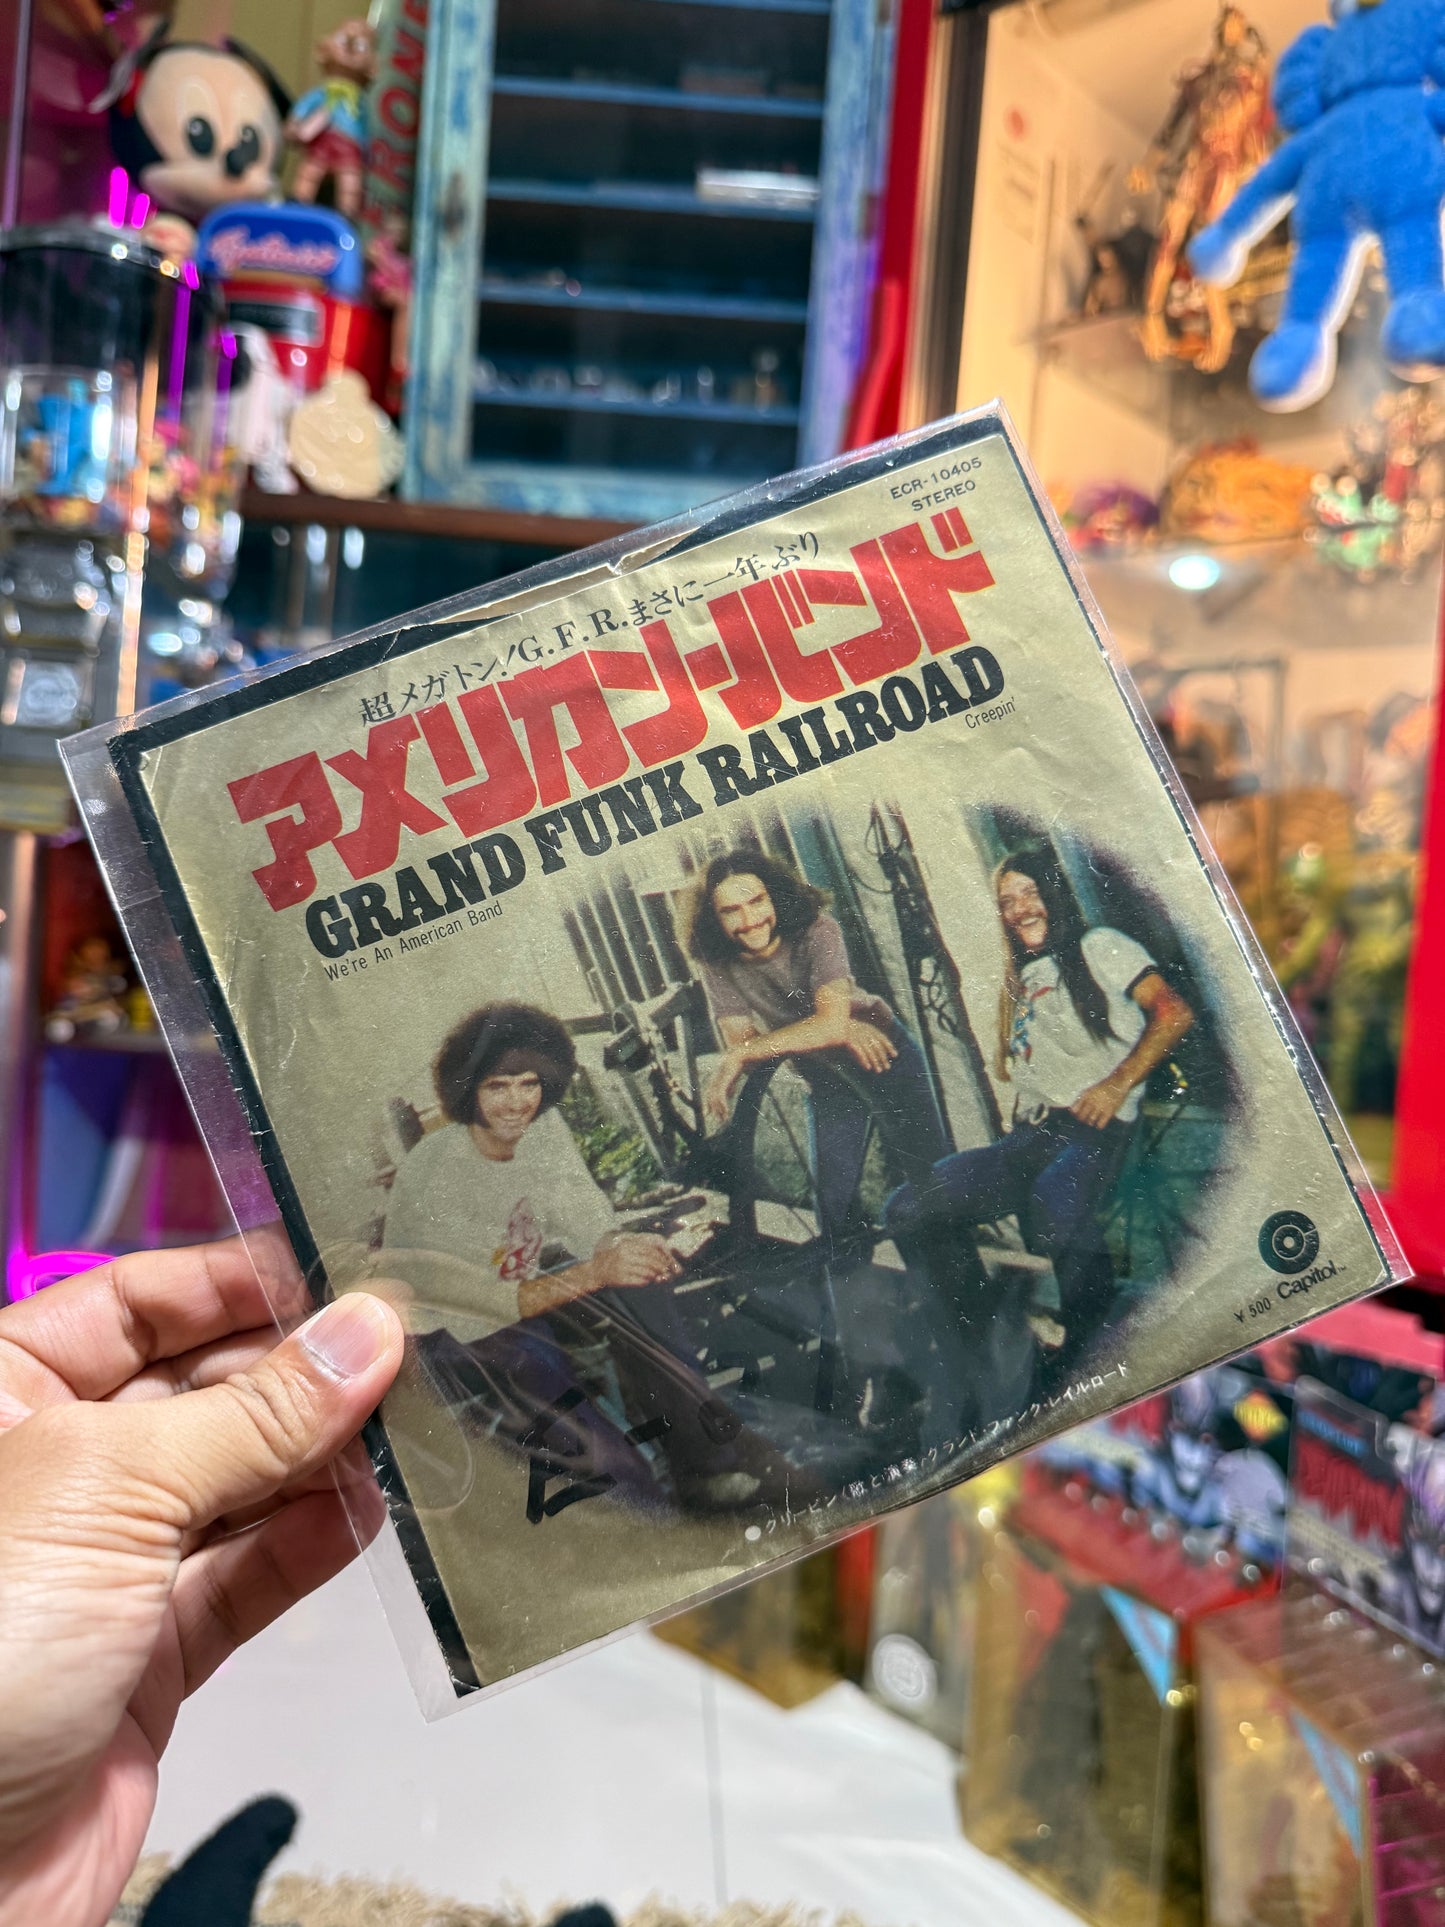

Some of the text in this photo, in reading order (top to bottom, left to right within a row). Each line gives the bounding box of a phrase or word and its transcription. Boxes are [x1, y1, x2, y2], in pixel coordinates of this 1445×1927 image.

[889, 456, 983, 500] ECR-10405
[911, 479, 977, 512] STEREO
[964, 696, 1017, 730] Creepin'
[305, 645, 1005, 959] GRAND FUNK RAILROAD
[323, 900, 504, 982] We're An American Band
[1276, 1259, 1337, 1300] Capitol
[1249, 1296, 1272, 1319] 500
